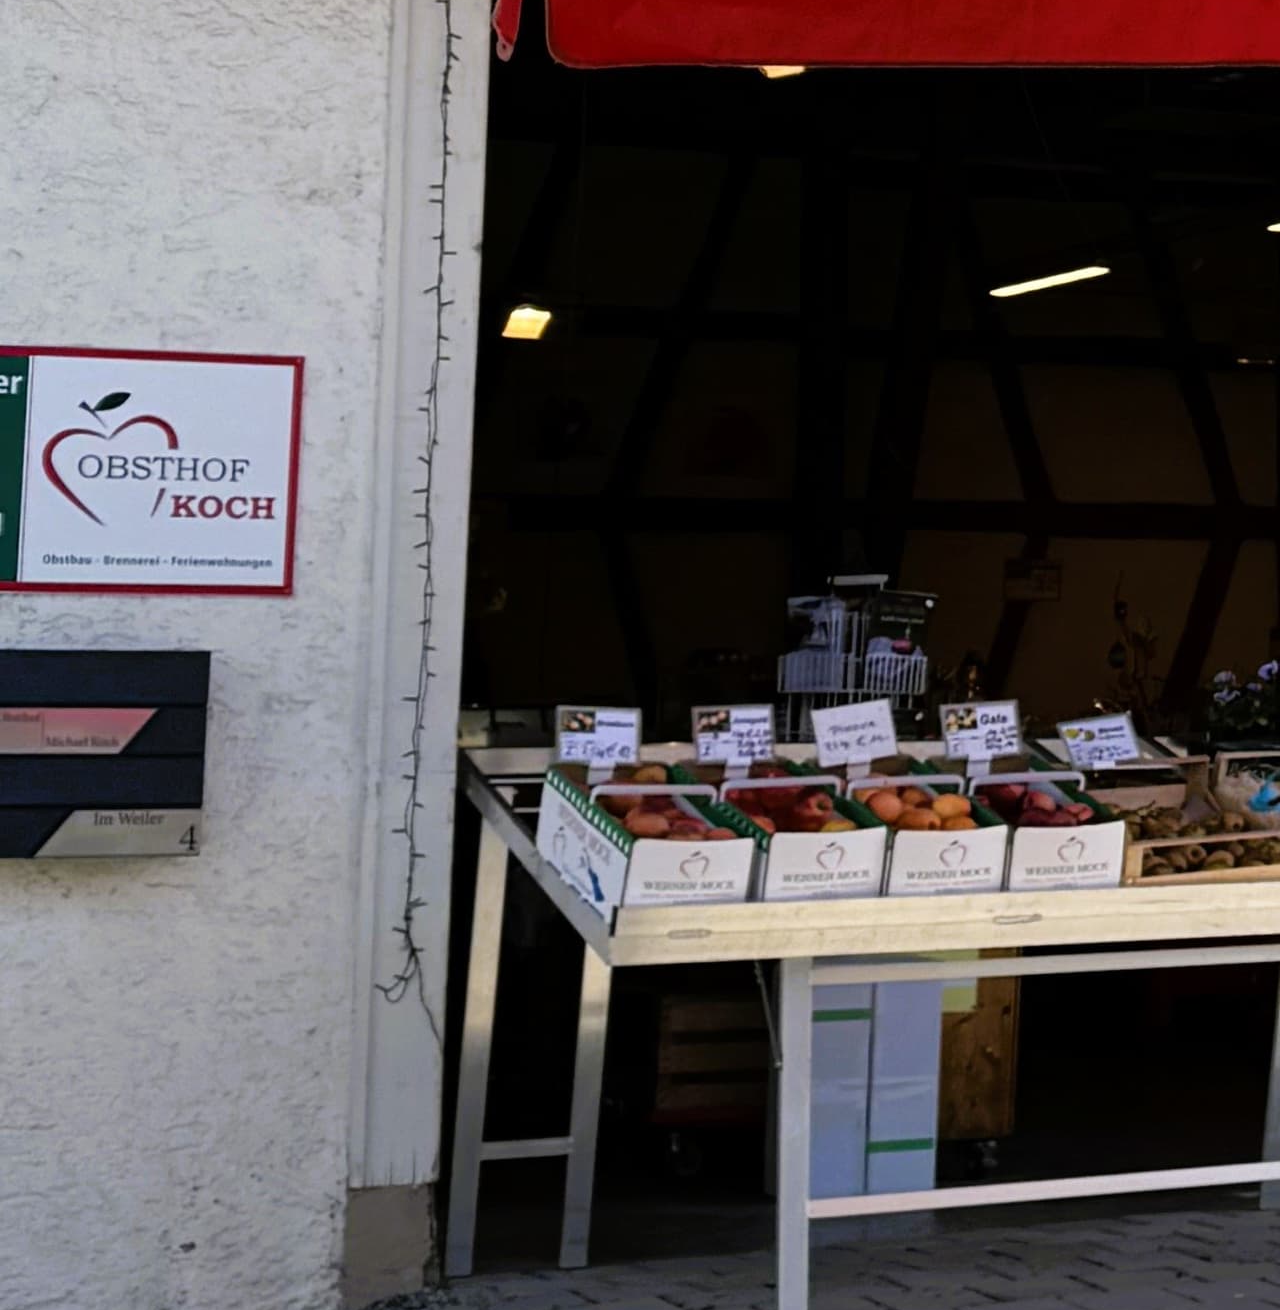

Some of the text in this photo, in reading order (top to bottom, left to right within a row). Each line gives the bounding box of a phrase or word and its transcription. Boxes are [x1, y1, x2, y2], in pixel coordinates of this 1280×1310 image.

[77, 453, 250, 483] OBSTHOF
[170, 494, 276, 520] KOCH
[42, 553, 273, 571] Obstbau Brennerei Ferienwohnungen
[93, 811, 165, 826] Im Weiler
[178, 824, 198, 851] 4
